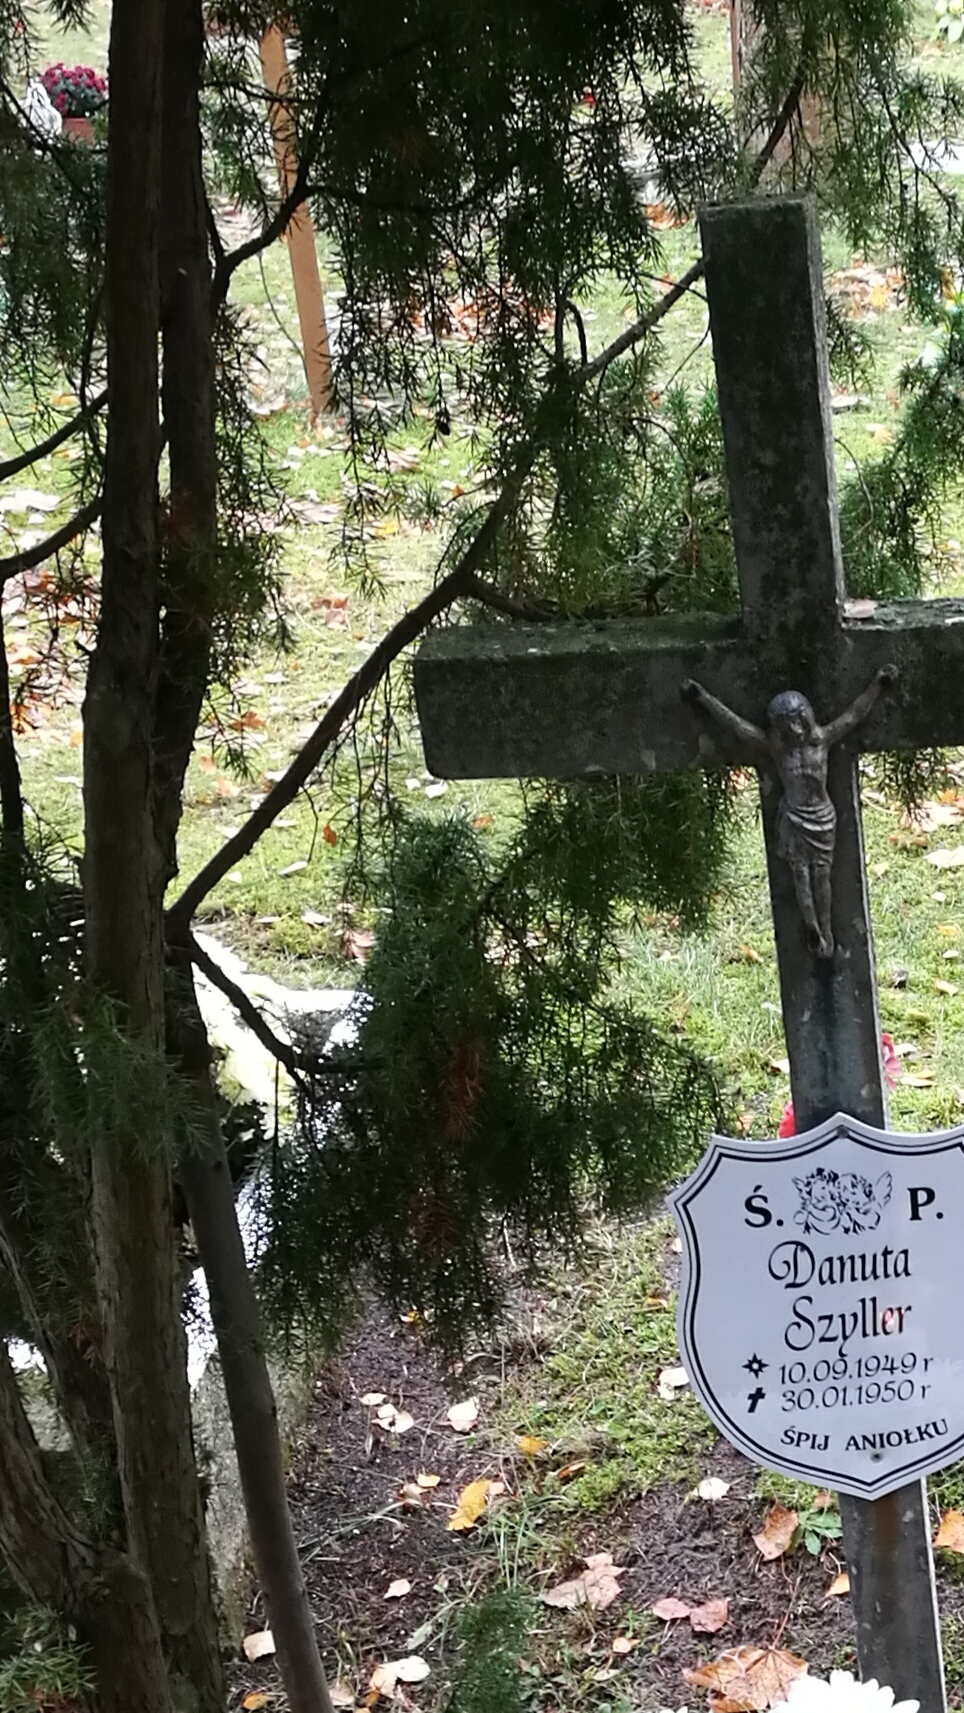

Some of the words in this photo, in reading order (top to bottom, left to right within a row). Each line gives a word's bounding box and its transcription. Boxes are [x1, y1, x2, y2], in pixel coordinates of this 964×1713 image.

[744, 1184, 784, 1228] Ś.
[907, 1187, 944, 1221] P.
[768, 1241, 912, 1289] Danuta
[784, 1296, 912, 1358] Szyller
[779, 1352, 917, 1386] 10.09.1949
[921, 1357, 934, 1372] r
[781, 1379, 915, 1412] 30.01.1950
[919, 1384, 931, 1399] r
[780, 1425, 830, 1451] ŚPIJ
[844, 1419, 948, 1452] ANIOŁKU
